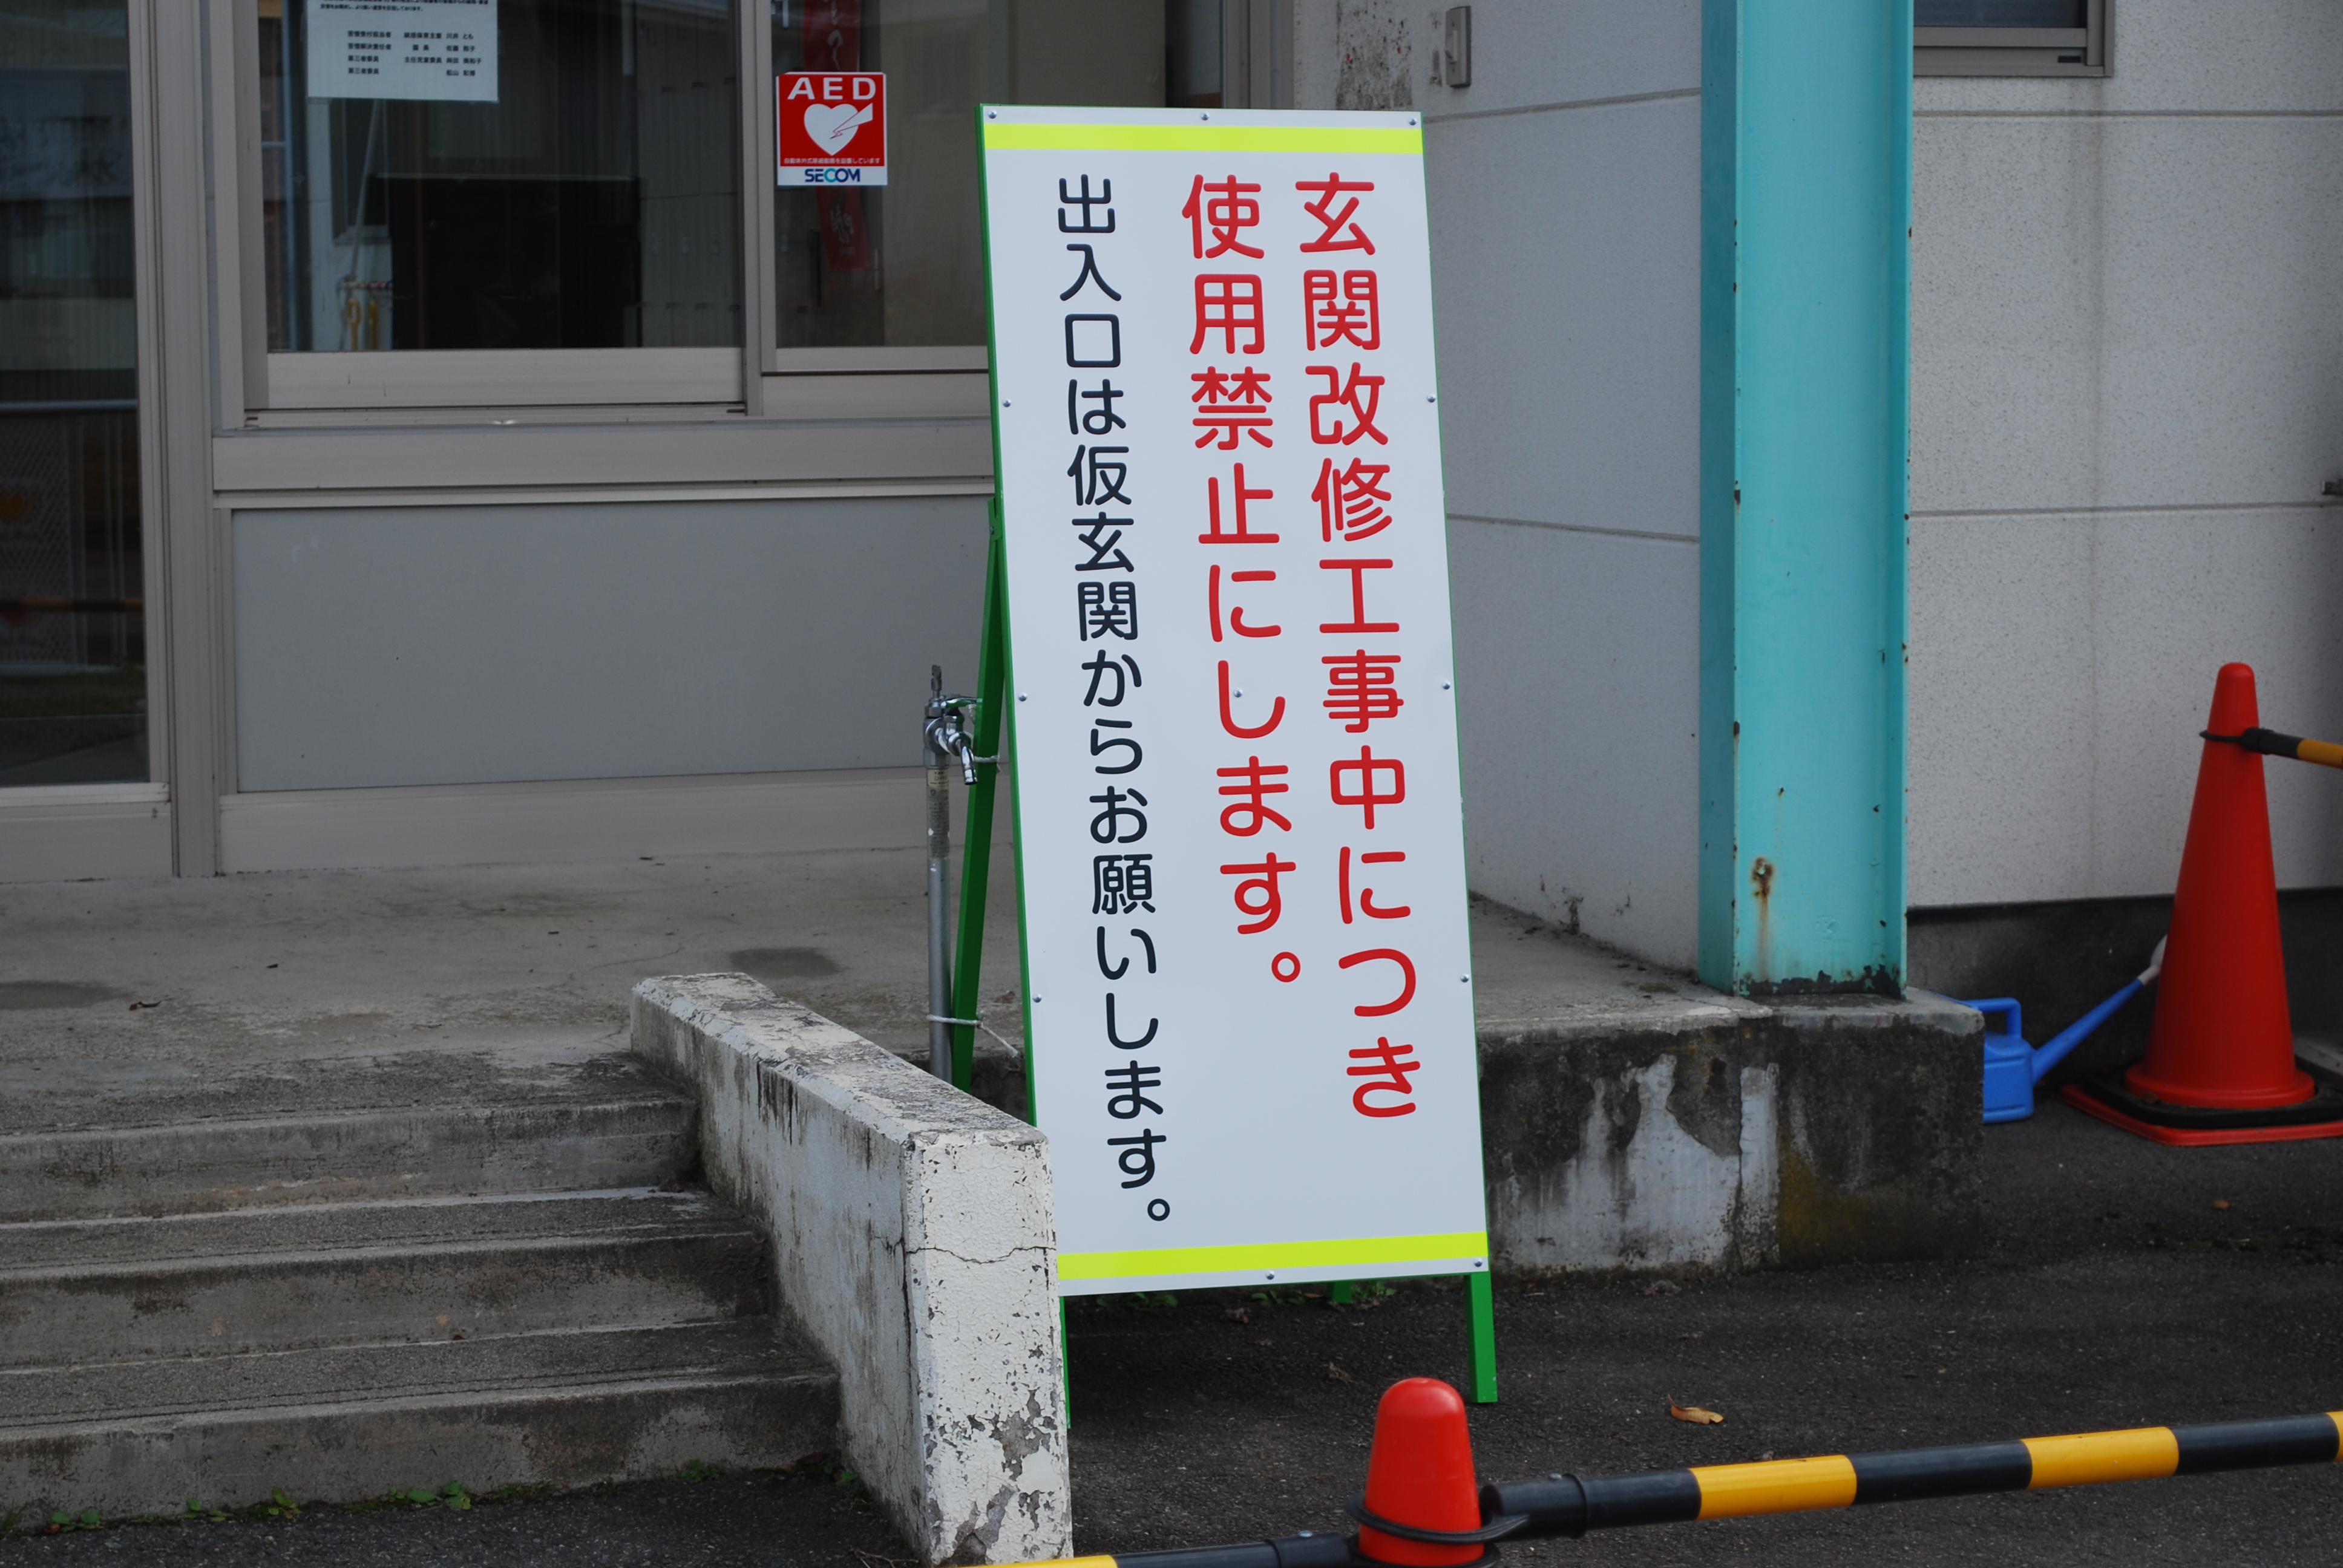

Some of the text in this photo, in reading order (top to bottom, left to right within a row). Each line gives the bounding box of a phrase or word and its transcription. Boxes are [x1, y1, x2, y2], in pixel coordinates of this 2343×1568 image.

[787, 77, 876, 100] AED
[805, 168, 860, 183] SECOM
[1058, 174, 1170, 1221] 出入口は仮玄関からお願いします。
[1182, 174, 1300, 983] 使用禁止にします。
[1296, 172, 1420, 1118] 玄関改修工事中につき
